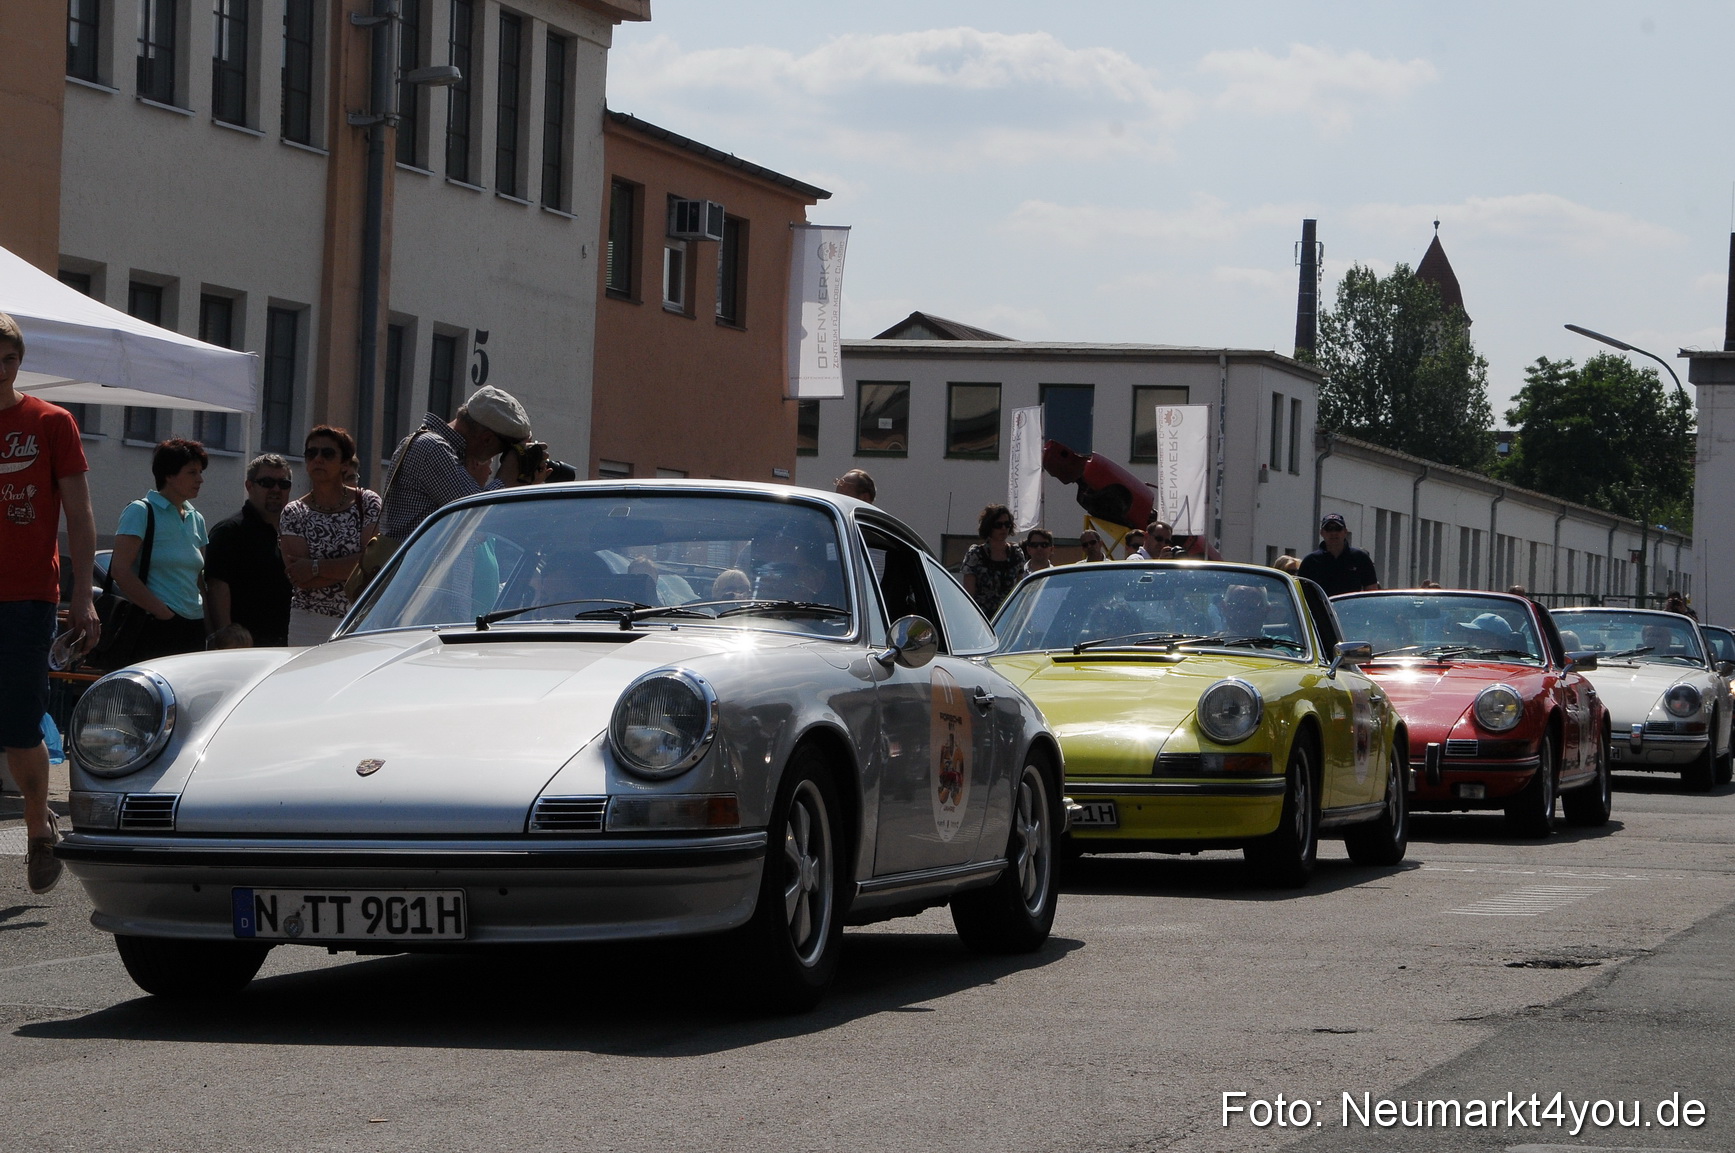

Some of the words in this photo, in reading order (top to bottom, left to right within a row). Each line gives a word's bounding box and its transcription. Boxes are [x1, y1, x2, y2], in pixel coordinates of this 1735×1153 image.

[817, 264, 831, 369] OFENWERK
[471, 328, 489, 386] 5
[1073, 805, 1115, 823] 1H
[241, 918, 249, 928] D
[255, 895, 278, 932] N
[303, 895, 351, 934] TT
[361, 896, 462, 934] 901H
